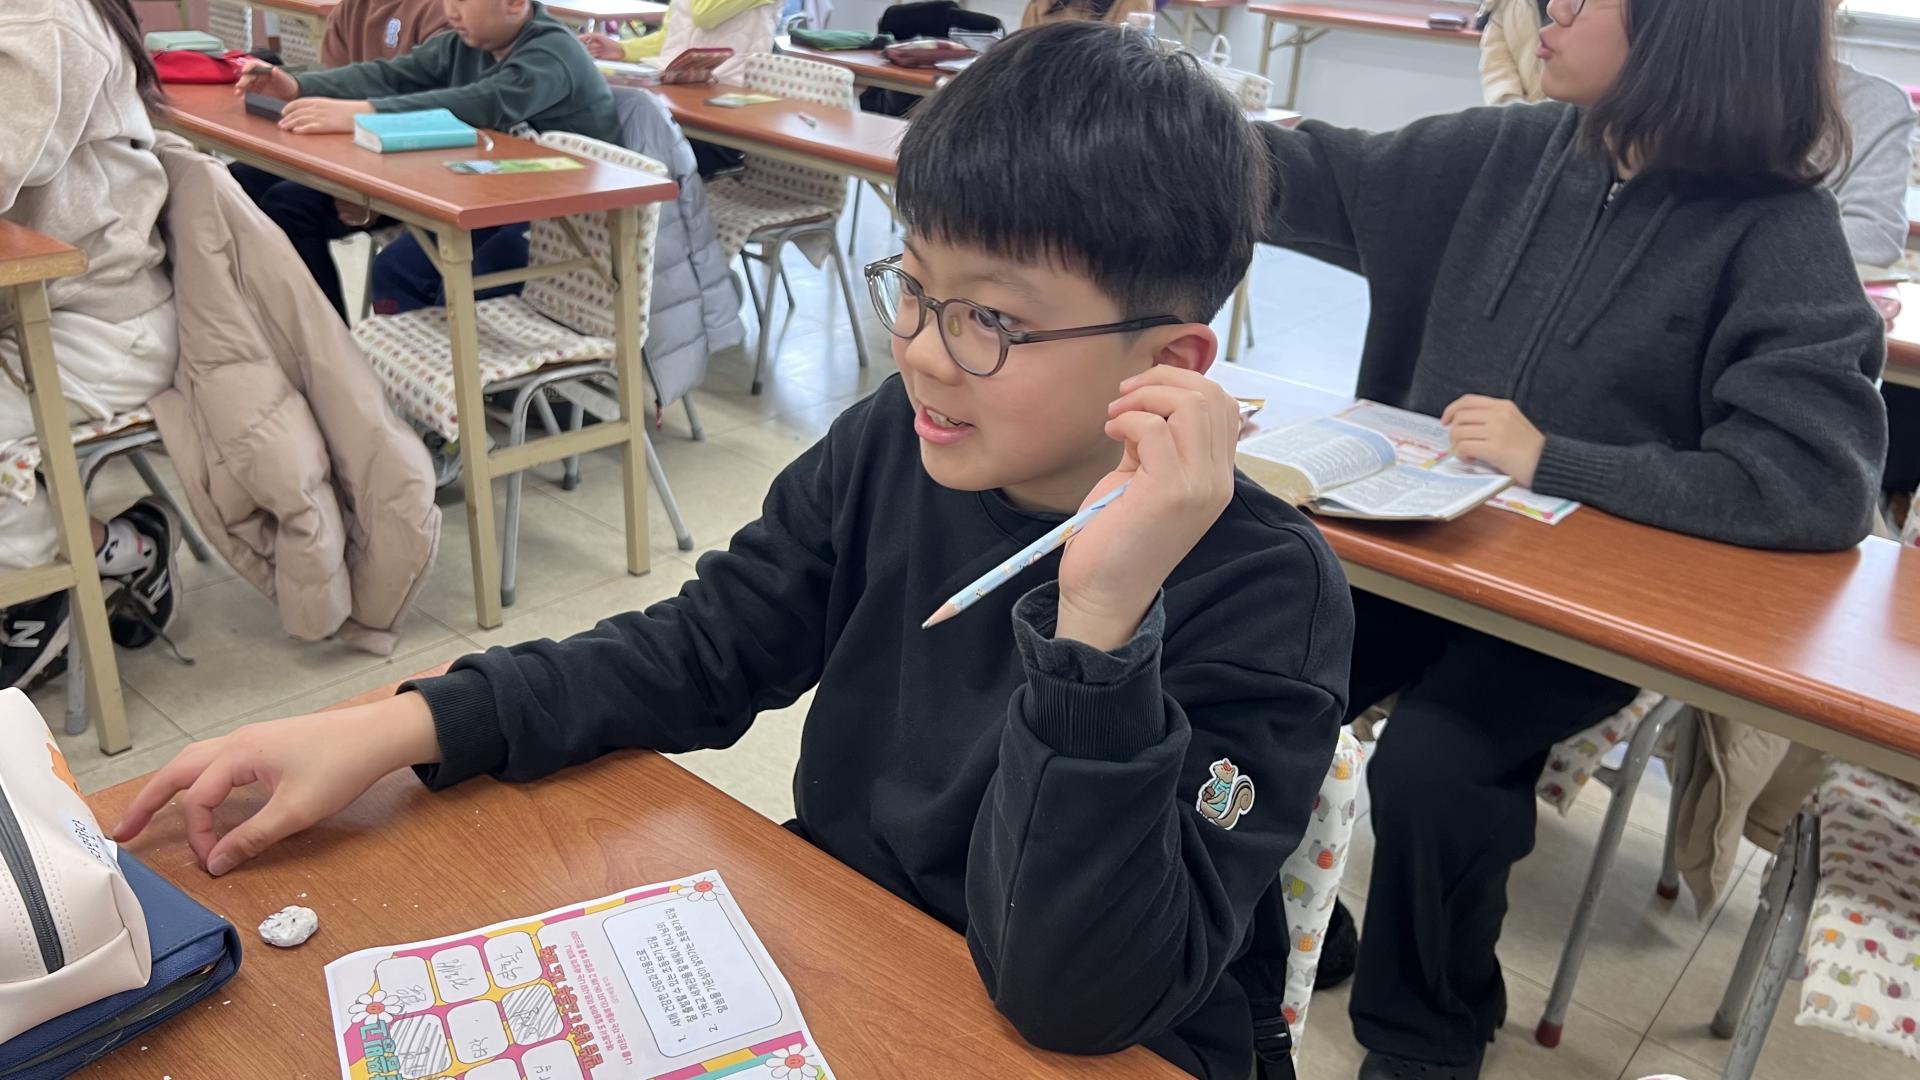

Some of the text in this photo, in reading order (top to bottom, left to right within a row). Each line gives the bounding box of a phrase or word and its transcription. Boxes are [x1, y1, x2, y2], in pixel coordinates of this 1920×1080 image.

[8, 620, 46, 648] N
[666, 908, 677, 919] 되길
[657, 922, 674, 945] 하나님의
[673, 920, 690, 942] 초등부가
[648, 936, 659, 949] 되길
[654, 949, 672, 973] 초등부가
[669, 946, 684, 964] 배워서
[686, 943, 703, 966] 살아가는
[668, 974, 679, 986] 있는
[682, 972, 700, 996] 세계관을
[556, 985, 579, 1017] 초등부
[636, 949, 686, 1043] 1. 새해 건강한 신앙과 마음으로
[695, 997, 711, 1017] 기독교
[710, 992, 728, 1013] 말씀을
[570, 1024, 594, 1045] 암송
[709, 1024, 718, 1032] 2.
[579, 1044, 604, 1071] 말씀
